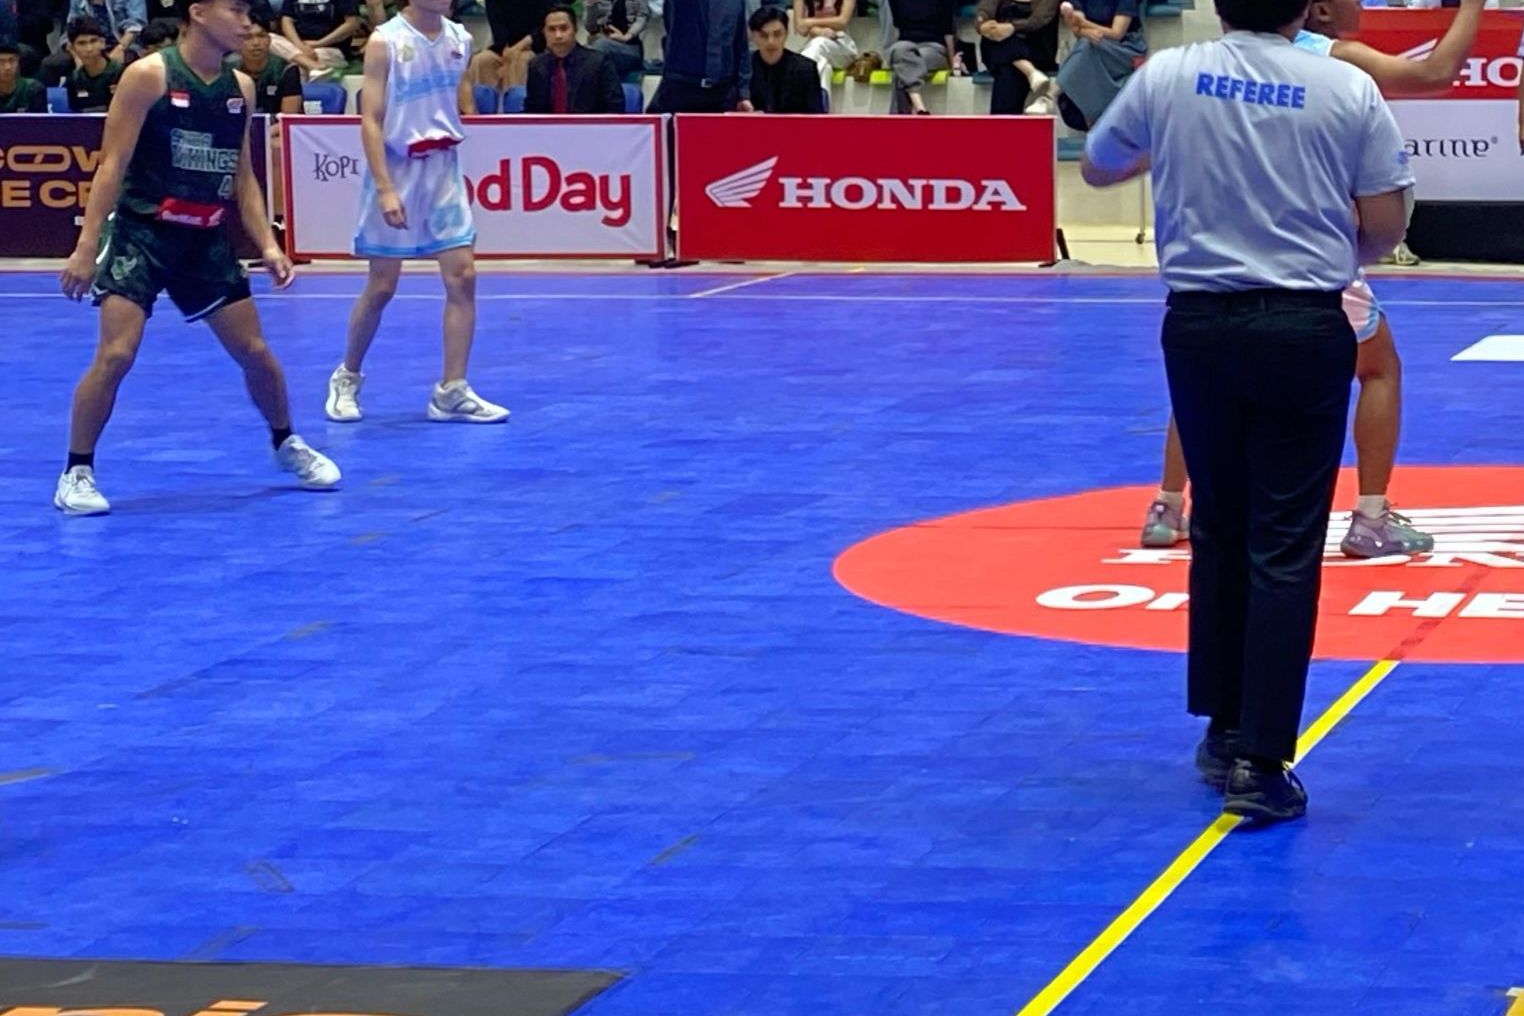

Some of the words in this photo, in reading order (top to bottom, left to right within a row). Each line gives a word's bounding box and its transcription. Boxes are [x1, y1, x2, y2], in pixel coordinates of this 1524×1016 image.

[1195, 72, 1306, 110] REFEREE
[521, 156, 632, 228] Day
[778, 176, 1028, 212] HONDA
